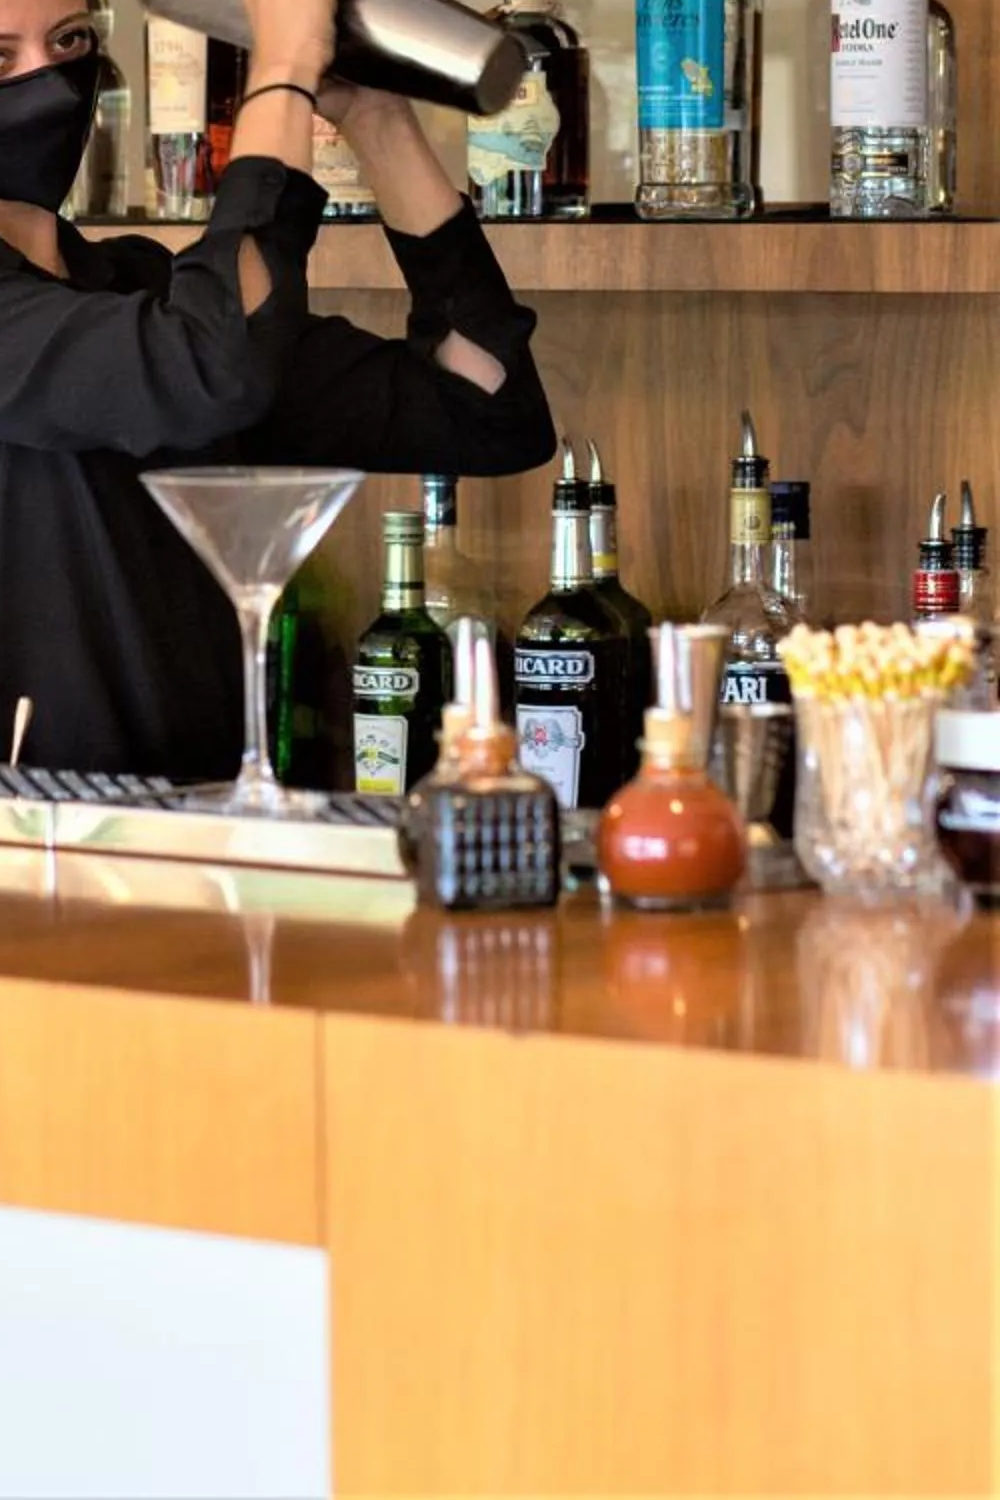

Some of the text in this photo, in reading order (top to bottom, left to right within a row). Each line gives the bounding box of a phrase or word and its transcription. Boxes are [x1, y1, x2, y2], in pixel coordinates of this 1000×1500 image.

[862, 18, 896, 39] One
[354, 674, 410, 690] ICARD
[722, 676, 768, 704] ARI
